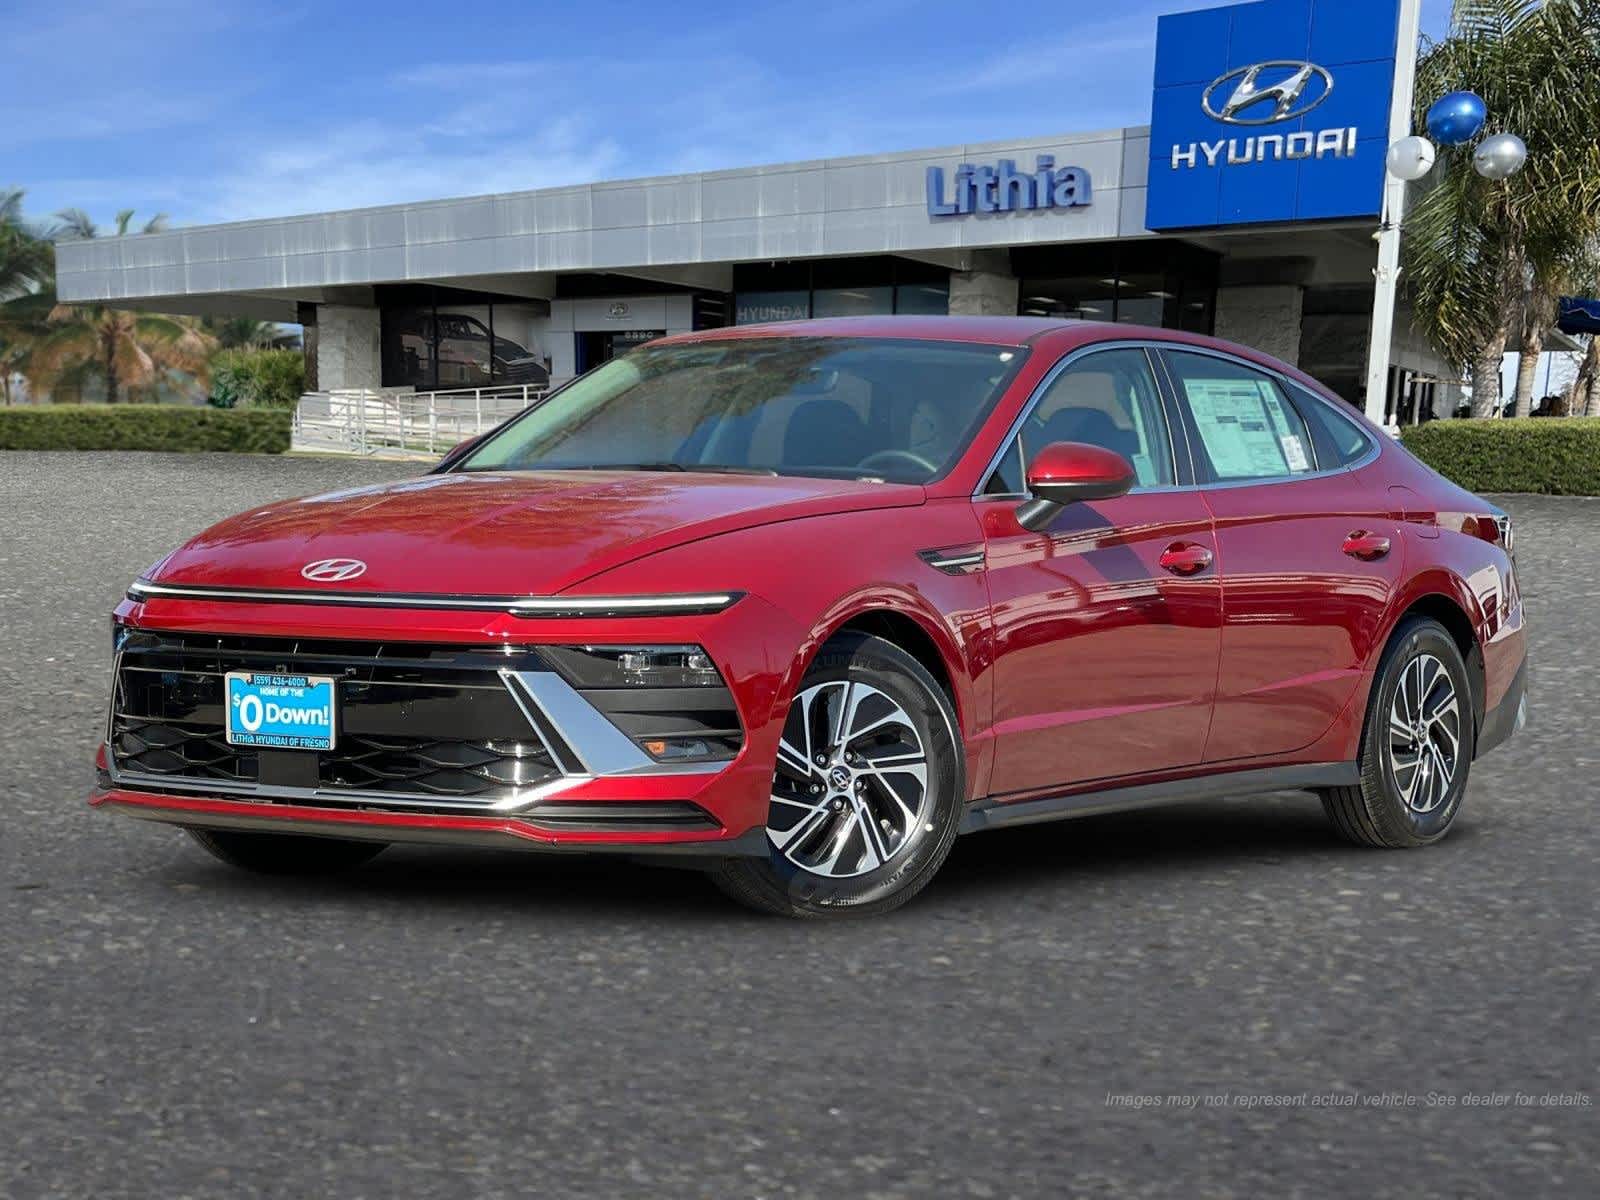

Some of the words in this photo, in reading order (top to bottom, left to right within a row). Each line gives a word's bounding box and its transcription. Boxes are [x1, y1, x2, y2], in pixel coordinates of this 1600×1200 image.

[1171, 127, 1357, 169] HYUNDAI
[926, 155, 1093, 217] Lithia
[737, 304, 808, 320] HYUNDAI
[272, 676, 306, 687] 436-6000
[260, 687, 279, 697] HOME
[280, 689, 290, 697] OF
[291, 689, 305, 698] THE
[265, 703, 329, 726] Down!
[256, 735, 288, 746] HYUNDAI
[289, 738, 299, 747] OF
[300, 738, 330, 749] FRESNO
